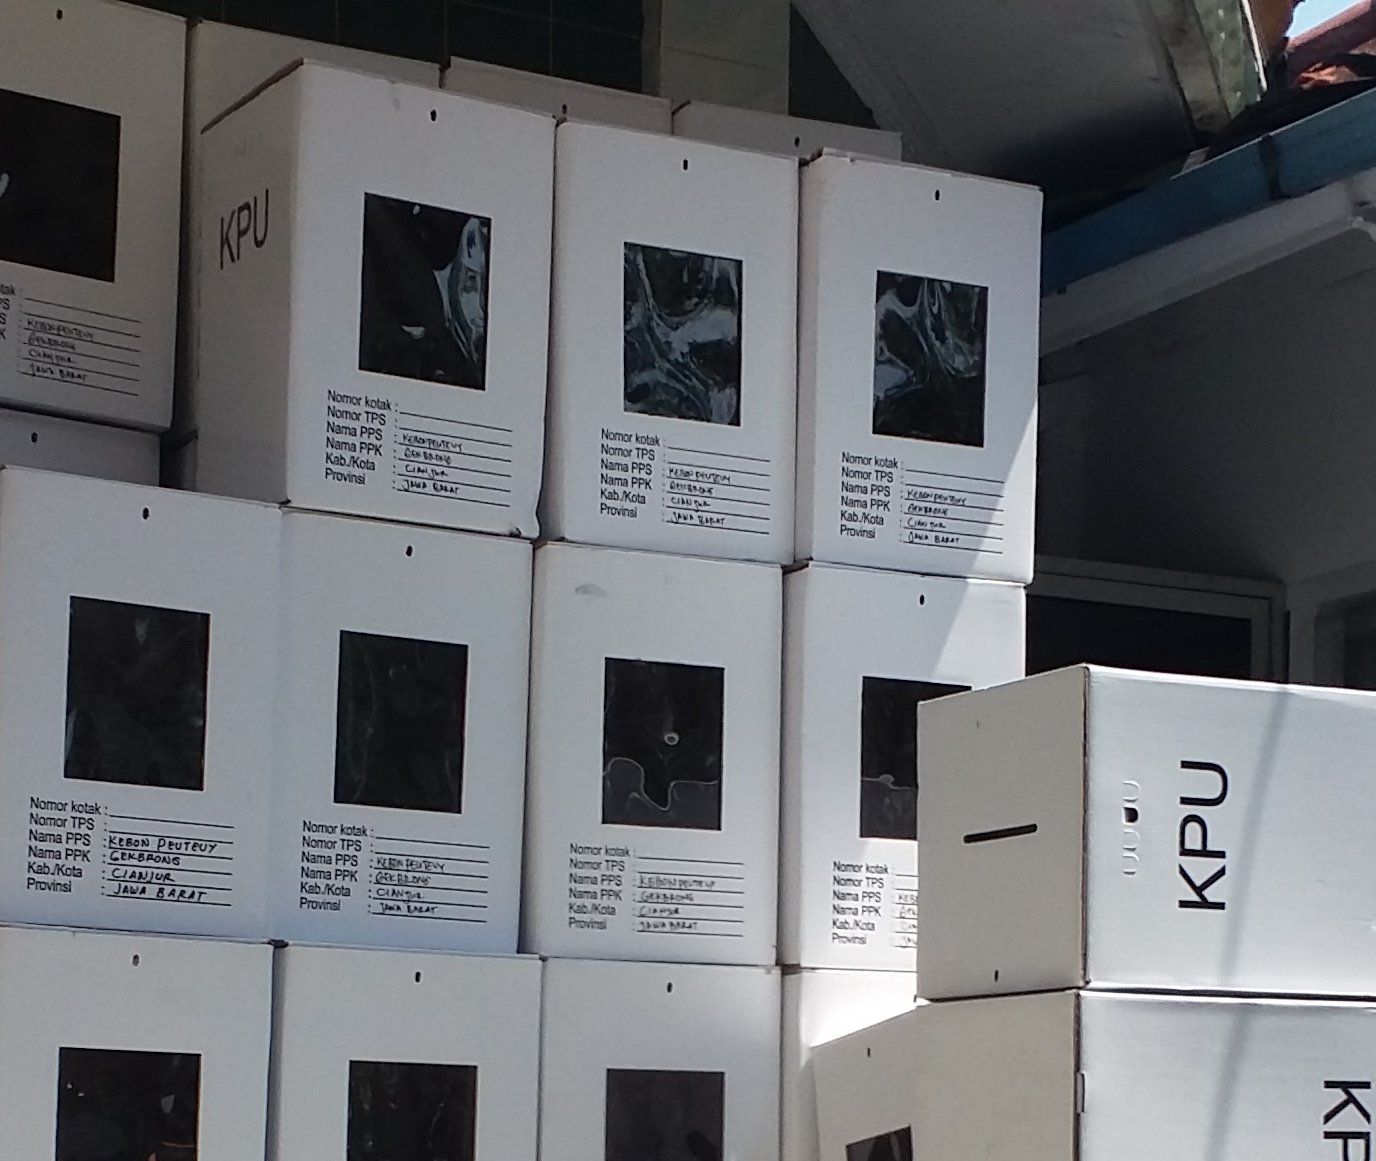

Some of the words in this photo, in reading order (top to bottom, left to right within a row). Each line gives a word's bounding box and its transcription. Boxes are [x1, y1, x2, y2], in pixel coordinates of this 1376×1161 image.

[218, 190, 271, 270] KPU
[327, 389, 362, 406] Nomor
[365, 396, 391, 411] kotak
[327, 405, 361, 421] Nomor
[364, 410, 386, 426] TPS
[326, 420, 357, 437] Nama
[360, 425, 383, 441] PPS
[326, 436, 356, 452] Nama
[359, 441, 382, 456] PPK
[325, 452, 375, 471] Kab./Kota
[325, 467, 365, 485] Provinsi
[30, 796, 68, 811] Nomor
[71, 800, 101, 815] kotak
[29, 812, 67, 828] Nomor
[70, 816, 95, 830] TPS
[29, 829, 62, 844] Nama
[66, 832, 91, 846] PPS
[108, 835, 150, 848] KEBON
[157, 838, 217, 853] PEUTEUY
[1177, 759, 1229, 911] KPU
[28, 845, 62, 860] Nama
[65, 848, 91, 862] PPK
[109, 850, 180, 865] GEKBRONG
[27, 861, 82, 878] Kab./Kota
[110, 868, 175, 884] CIANJUR
[27, 877, 71, 892] Provinsi
[113, 882, 146, 895] JAWA
[156, 887, 207, 902] BARAT
